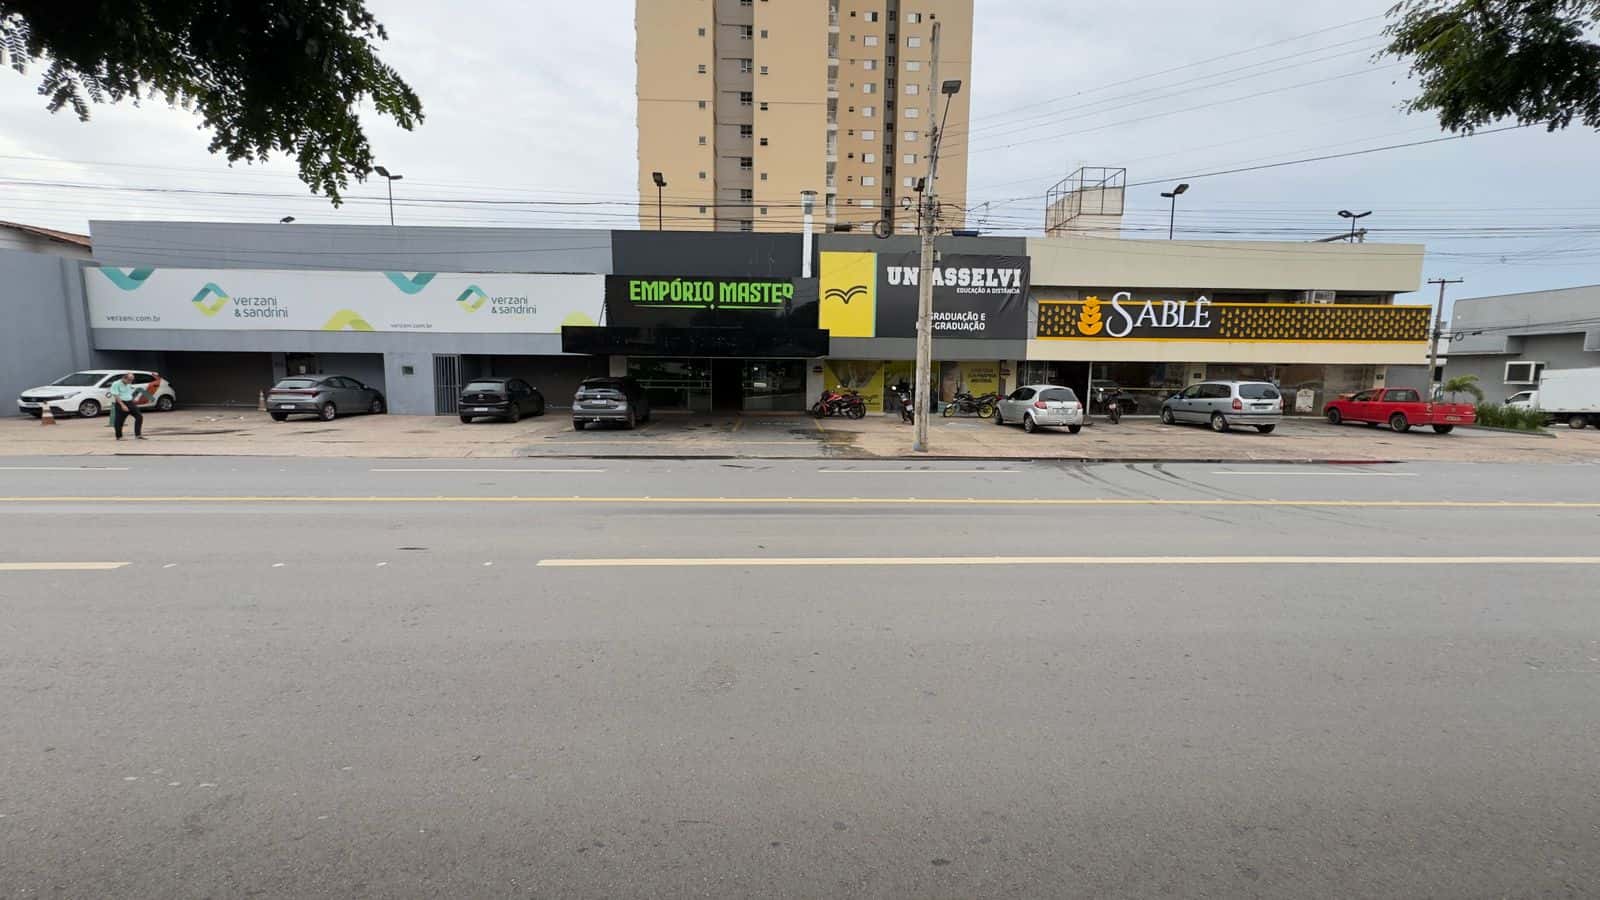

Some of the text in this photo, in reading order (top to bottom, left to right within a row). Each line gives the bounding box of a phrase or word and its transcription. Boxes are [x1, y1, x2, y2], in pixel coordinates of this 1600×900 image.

[887, 266, 1021, 287] UNASSELVI
[629, 278, 794, 303] EMPÓRIO MASTER
[956, 286, 986, 295] EDUCAÇÃO
[233, 295, 278, 306] verzani
[490, 295, 528, 305] verzani
[234, 306, 289, 318] & sandrini
[490, 305, 537, 315] & sandrini
[1105, 292, 1213, 338] SABLÊ
[980, 312, 986, 321] E
